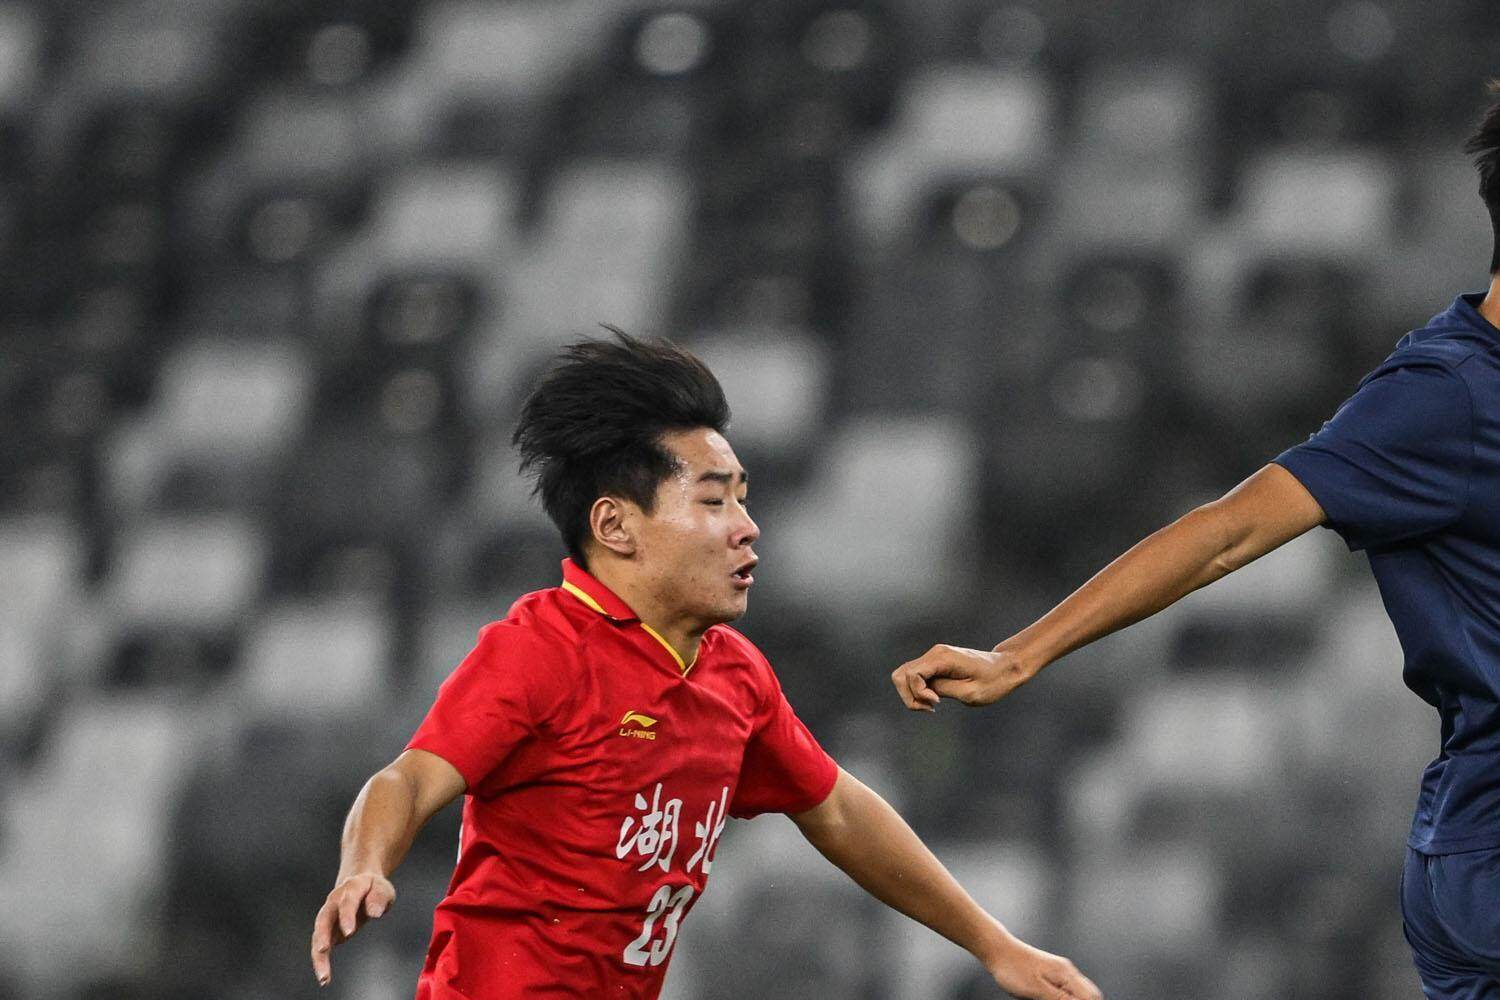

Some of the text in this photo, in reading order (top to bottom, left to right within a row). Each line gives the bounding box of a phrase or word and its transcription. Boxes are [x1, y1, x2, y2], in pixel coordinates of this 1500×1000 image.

[619, 728, 656, 740] LI-NING
[616, 783, 728, 874] 湖北
[623, 885, 694, 966] 23
